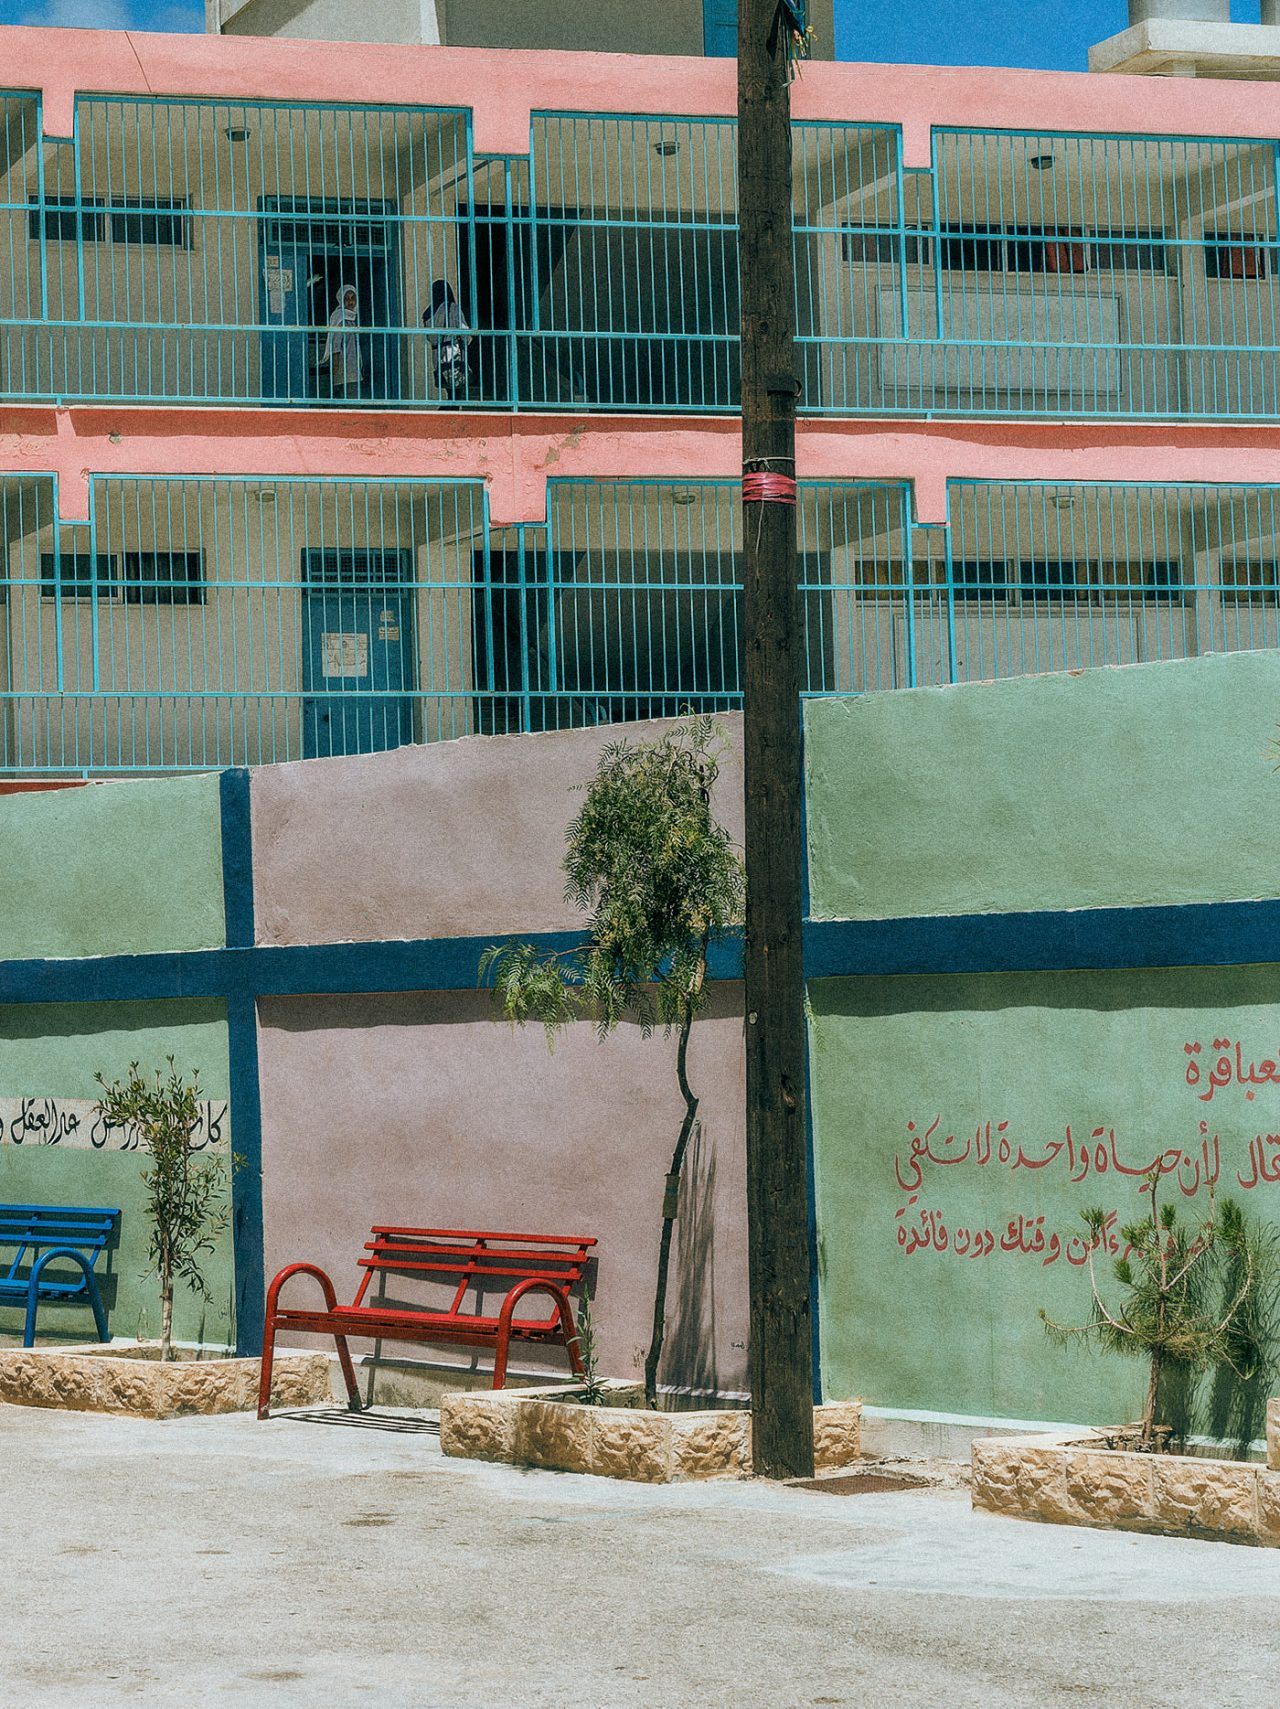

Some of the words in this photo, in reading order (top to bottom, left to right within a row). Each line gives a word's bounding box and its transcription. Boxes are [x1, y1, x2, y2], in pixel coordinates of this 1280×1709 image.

[1183, 1037, 1280, 1102] عباقرة
[997, 1119, 1090, 1183] واحدة
[1091, 1125, 1184, 1194] حياة
[894, 1207, 950, 1255] فائدة
[952, 1227, 995, 1259] دون
